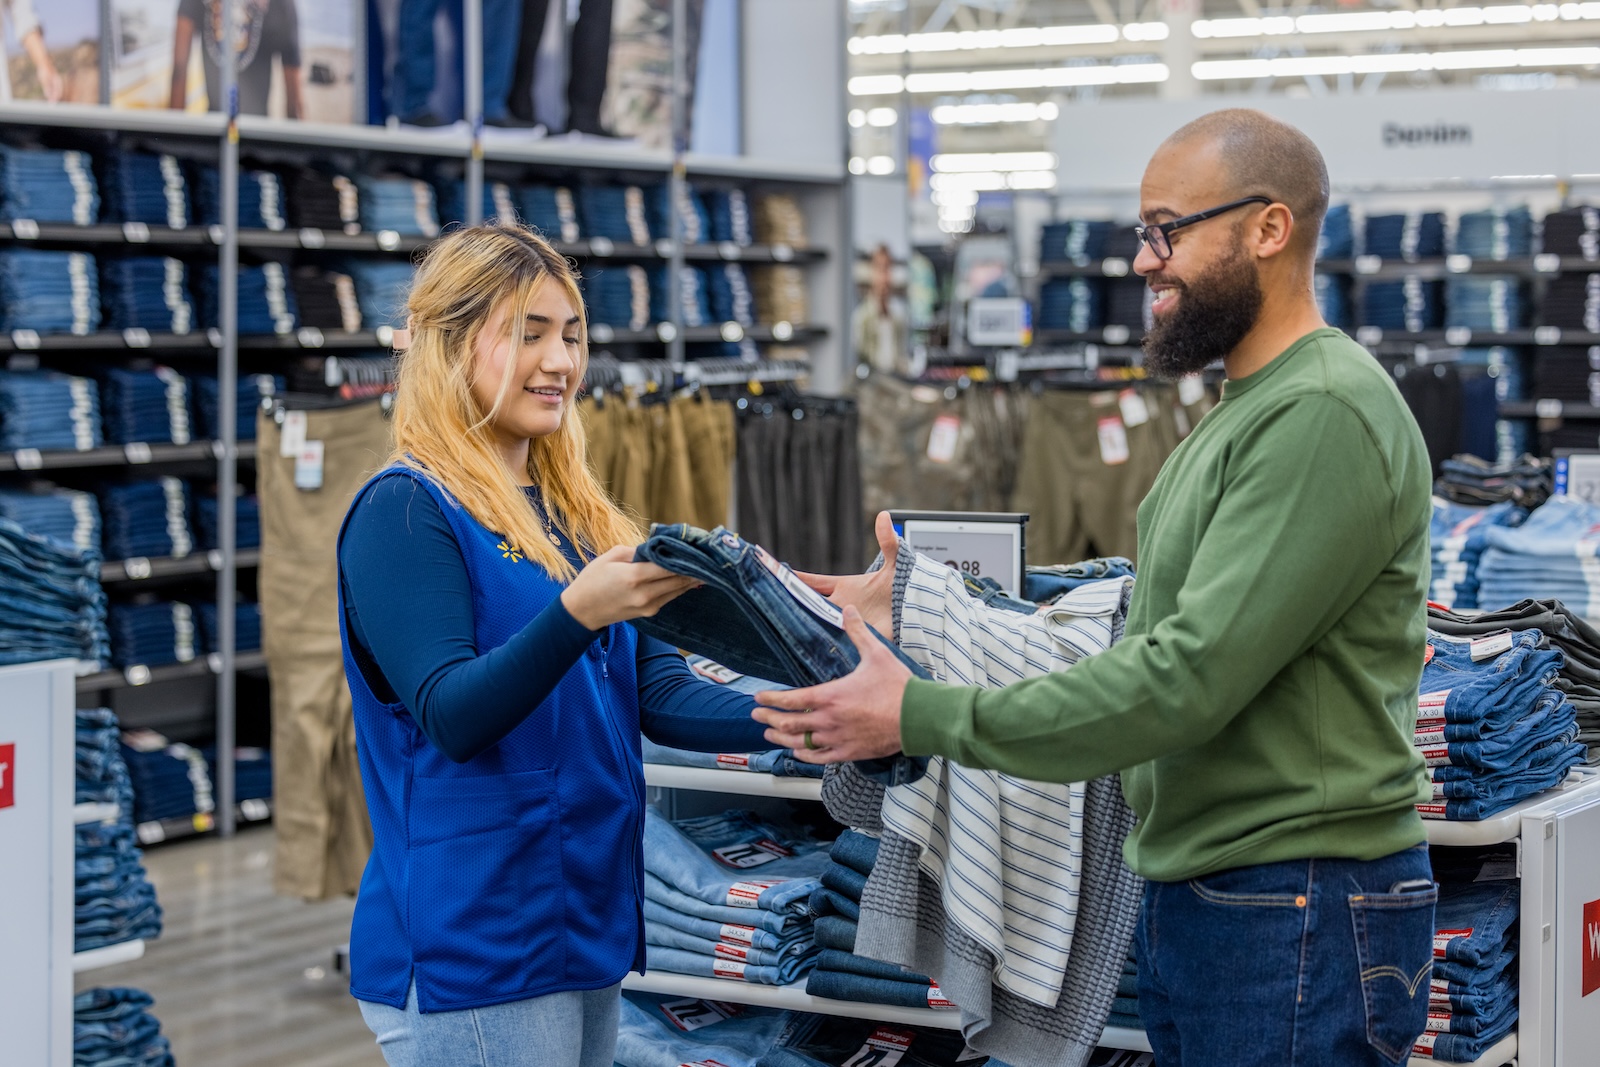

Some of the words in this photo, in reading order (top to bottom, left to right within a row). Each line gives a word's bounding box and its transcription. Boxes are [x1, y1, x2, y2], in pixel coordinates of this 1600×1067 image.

[1382, 121, 1472, 147] Denim
[732, 898, 752, 906] 34X34
[727, 928, 746, 937] 34X34
